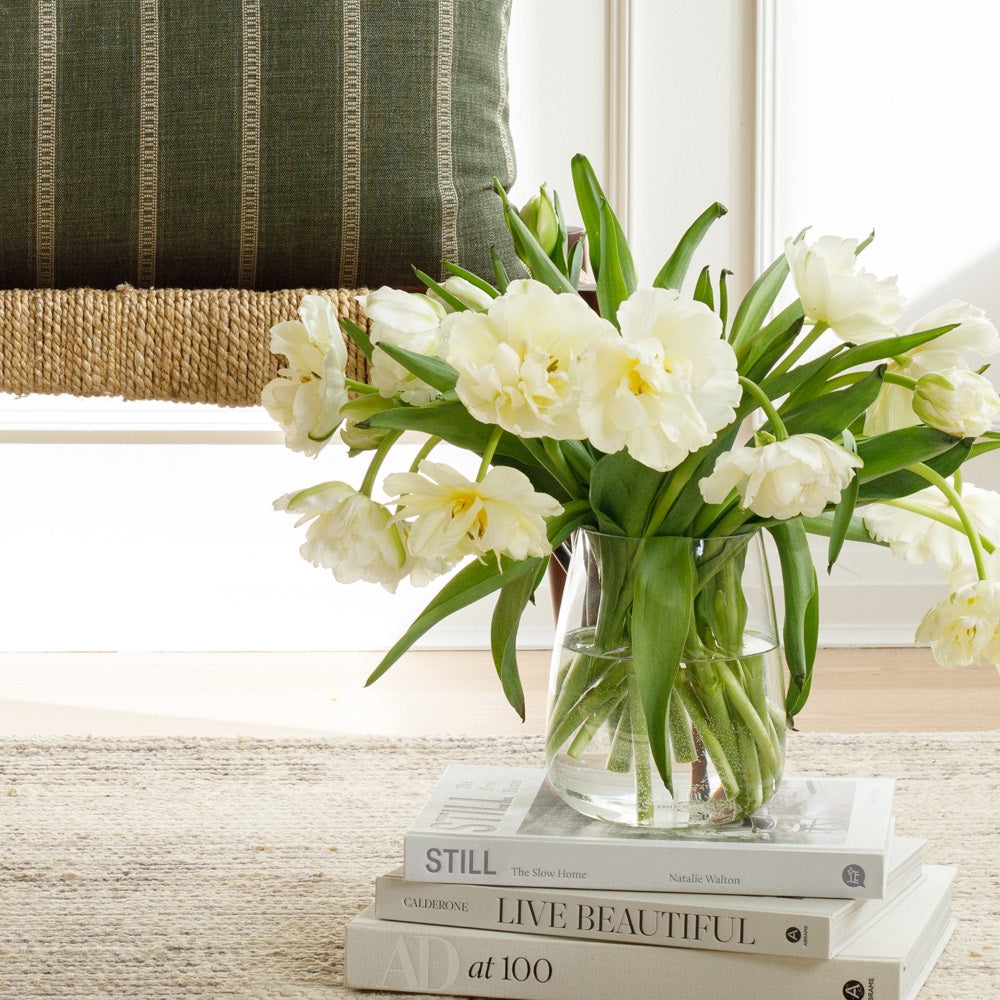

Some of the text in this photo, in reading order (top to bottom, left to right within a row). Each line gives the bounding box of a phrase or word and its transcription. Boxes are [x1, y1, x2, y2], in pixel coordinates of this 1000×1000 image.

[431, 796, 514, 833] STILL
[425, 847, 587, 879] STILL The Slow Home
[669, 873, 740, 885] Natalie Walton
[403, 897, 469, 913] CALDERONE
[496, 897, 756, 945] LIVE BEAUTIFUL
[376, 934, 553, 991] AD at 100
[868, 978, 876, 1000] BRAMS
